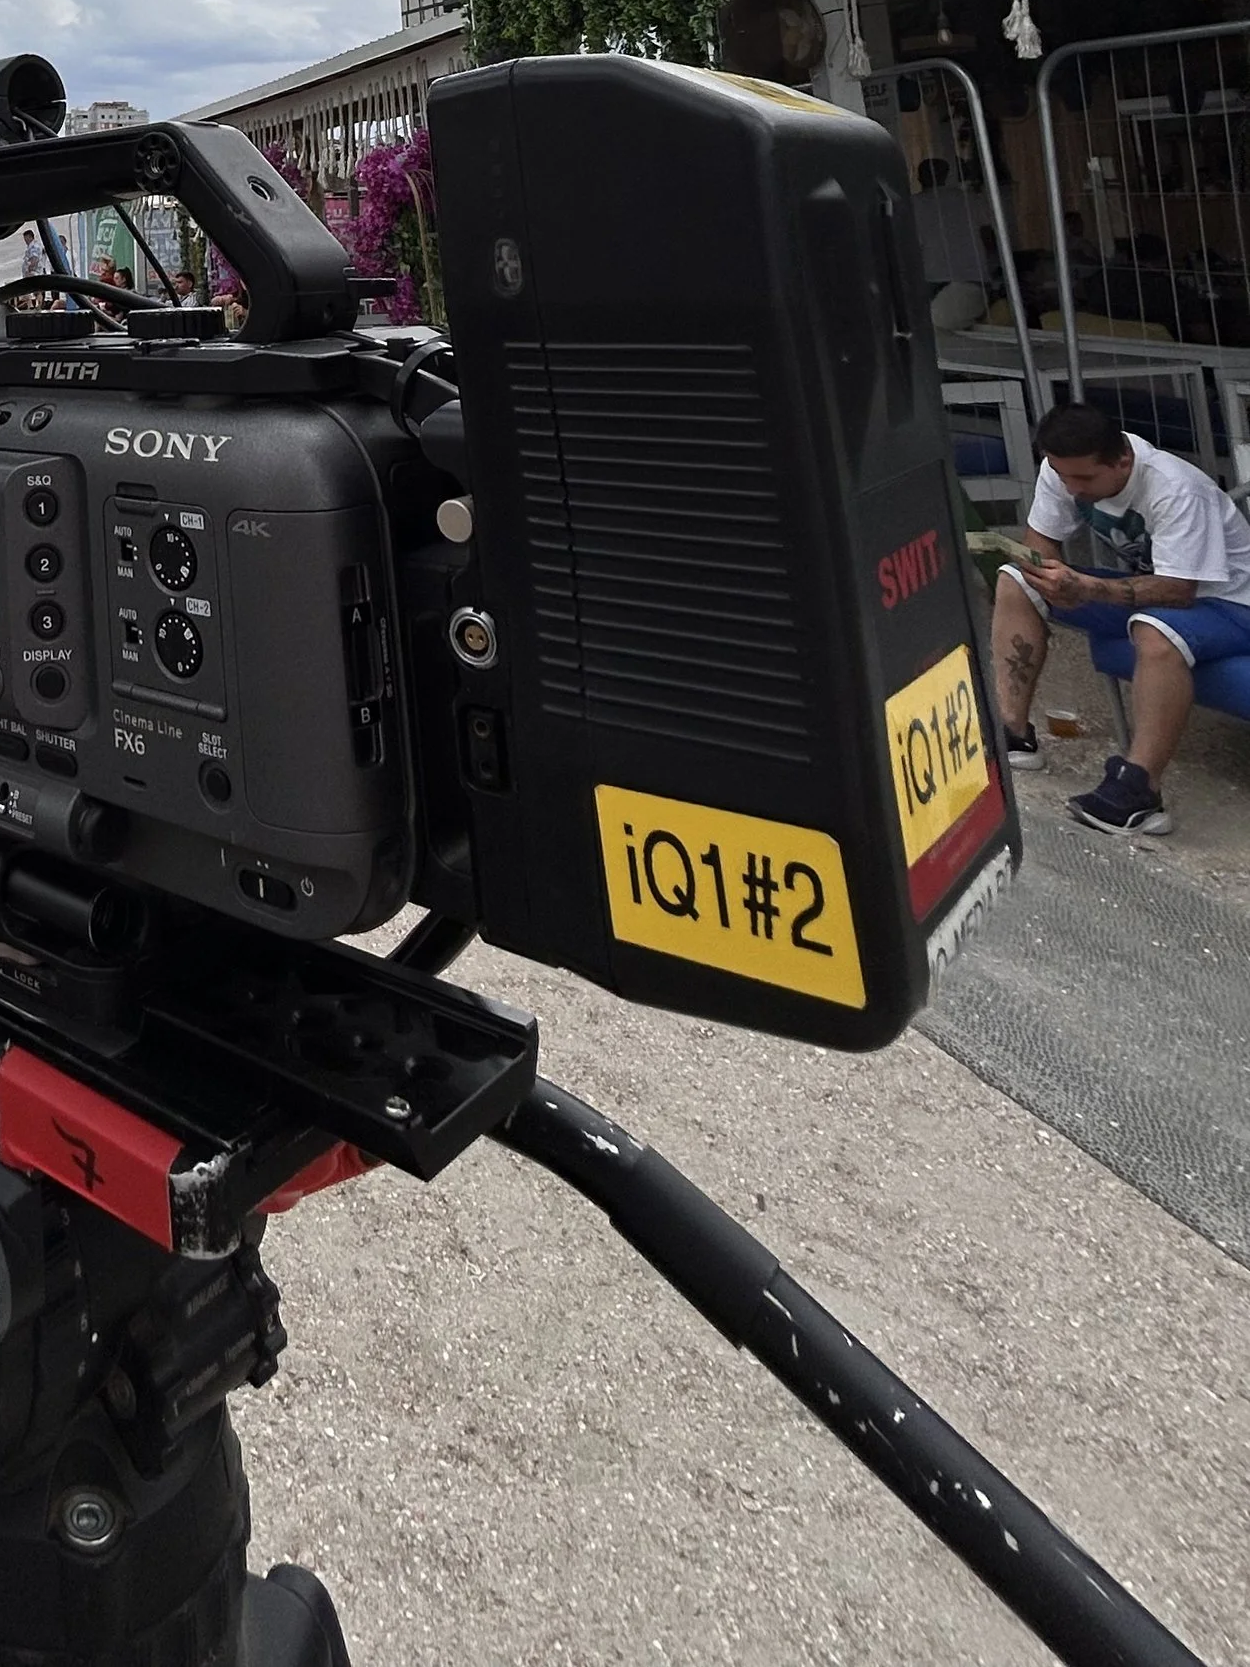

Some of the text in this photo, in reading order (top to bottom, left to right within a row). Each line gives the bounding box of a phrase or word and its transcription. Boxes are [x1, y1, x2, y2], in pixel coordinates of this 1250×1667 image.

[31, 361, 100, 381] TILTA
[31, 411, 45, 425] P
[104, 427, 232, 462] SONY
[27, 475, 52, 486] S&Q
[38, 502, 46, 515] 1
[181, 514, 204, 529] CH-1
[232, 519, 272, 538] 4K
[114, 525, 132, 537] AUTO
[40, 558, 50, 572] 2
[117, 566, 134, 578] MAN
[877, 529, 940, 610] SWIT
[118, 607, 138, 620] AUTO
[187, 599, 210, 615] CH-2
[352, 607, 362, 623] A
[42, 615, 53, 629] 3
[23, 649, 73, 662] DISPLAY
[122, 650, 139, 662] MAN
[360, 707, 371, 723] B
[10, 721, 27, 736] BAL
[113, 709, 183, 739] Cinema Line
[35, 729, 76, 751] SHUTTER
[114, 728, 146, 755] FX6
[201, 732, 222, 747] SLOT
[198, 742, 228, 759] SELECT
[897, 679, 980, 817] iQ1#2
[623, 822, 833, 957] iQ1#2
[14, 968, 41, 990] LOCK
